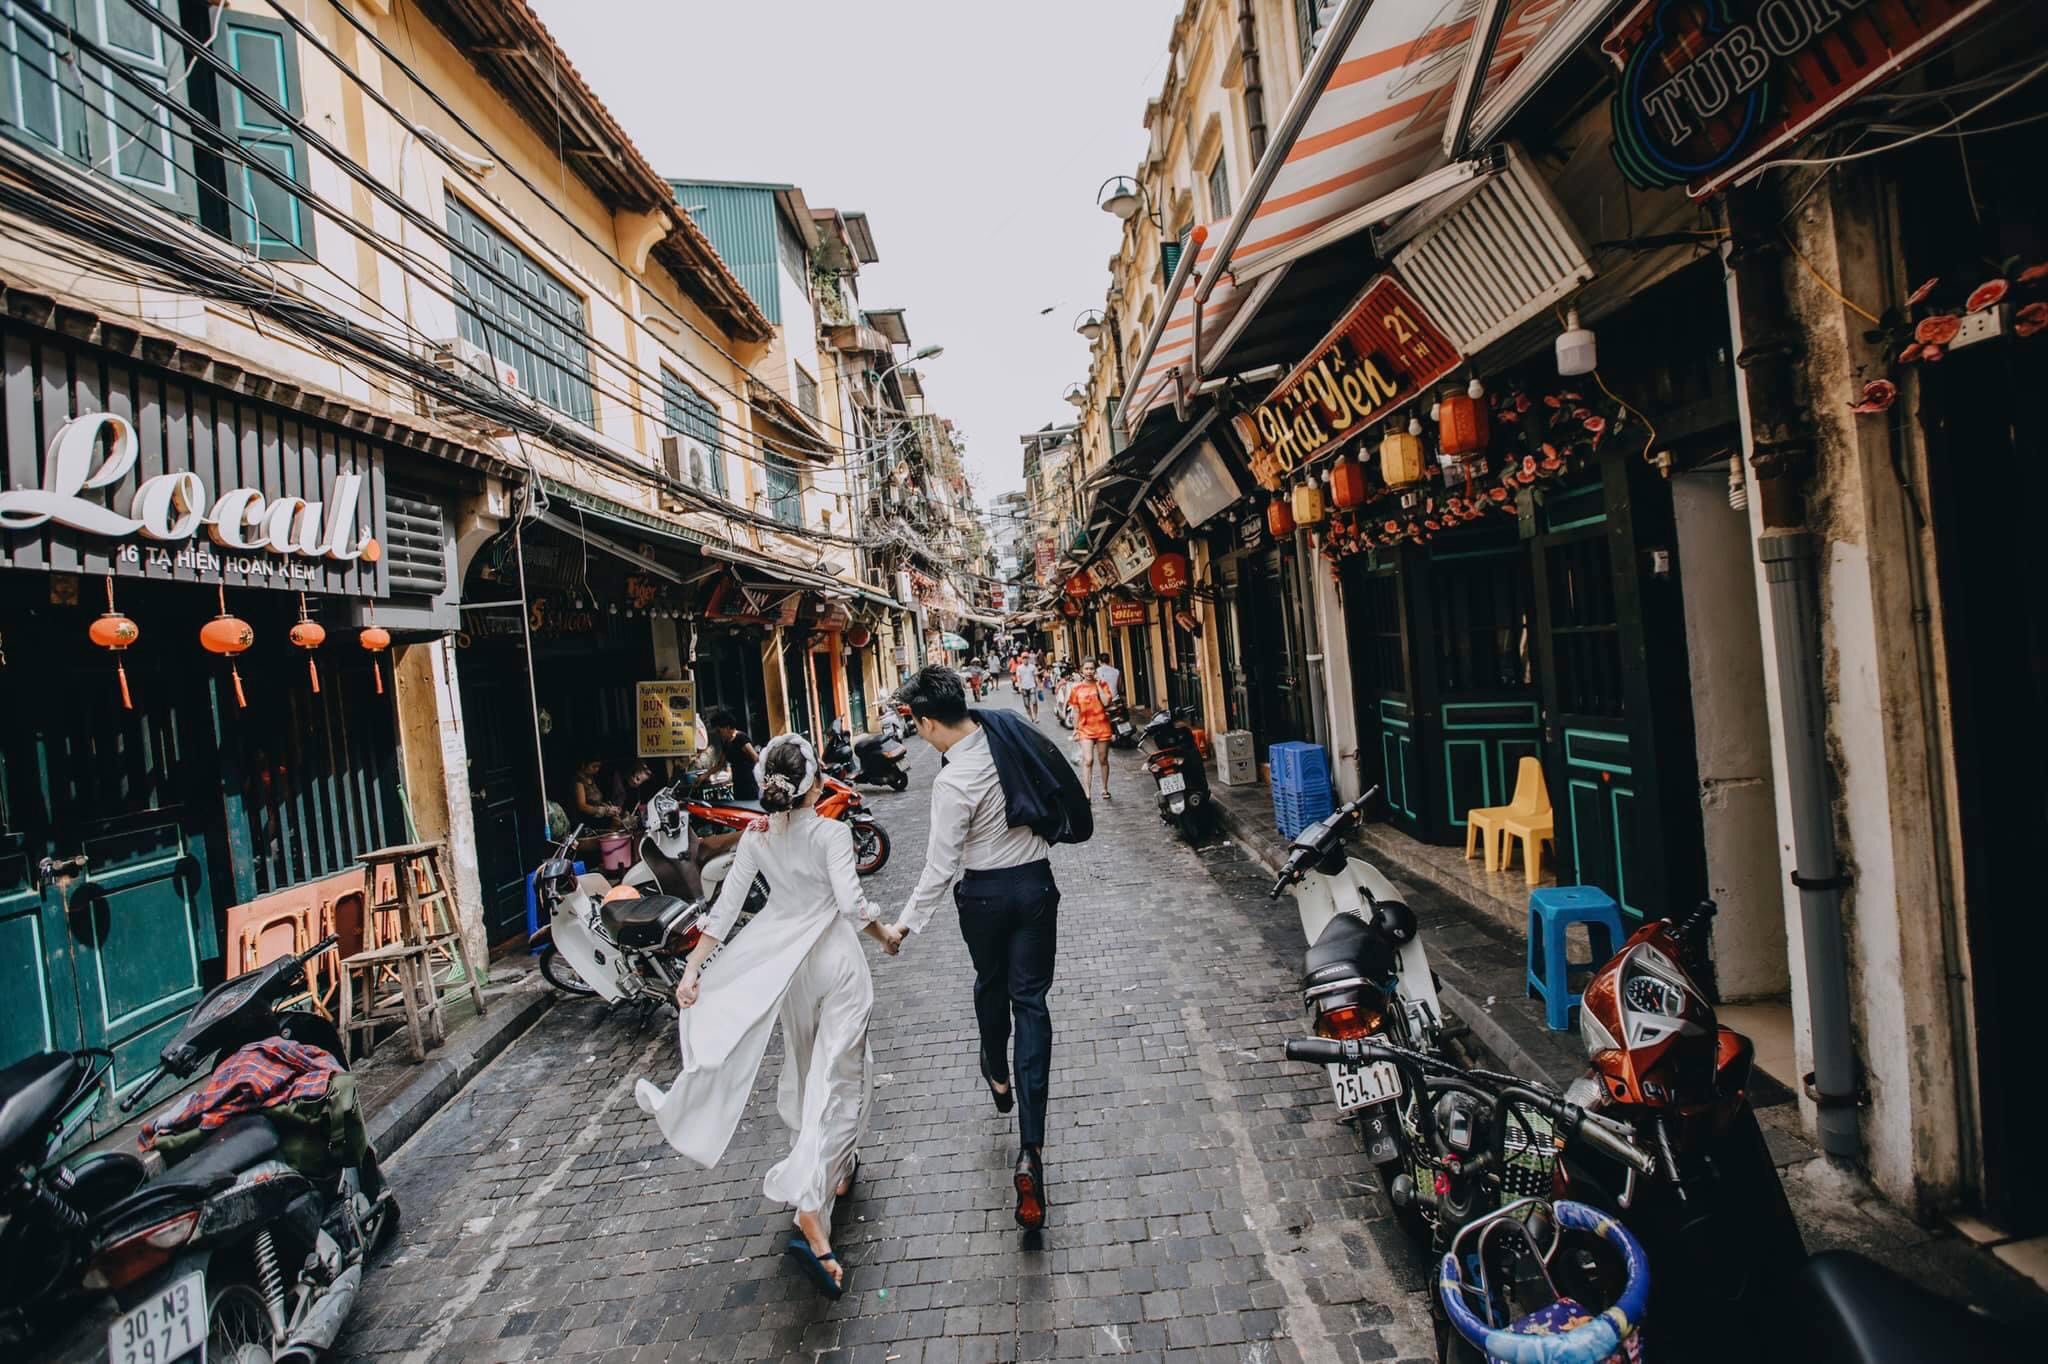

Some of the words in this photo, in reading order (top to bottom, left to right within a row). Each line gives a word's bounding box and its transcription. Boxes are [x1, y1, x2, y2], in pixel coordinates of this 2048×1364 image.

[1383, 304, 1419, 344] 21
[0, 412, 363, 560] Local
[117, 544, 139, 563] 16
[1336, 1067, 1396, 1108] 254.11
[123, 1284, 190, 1348] 30-N3
